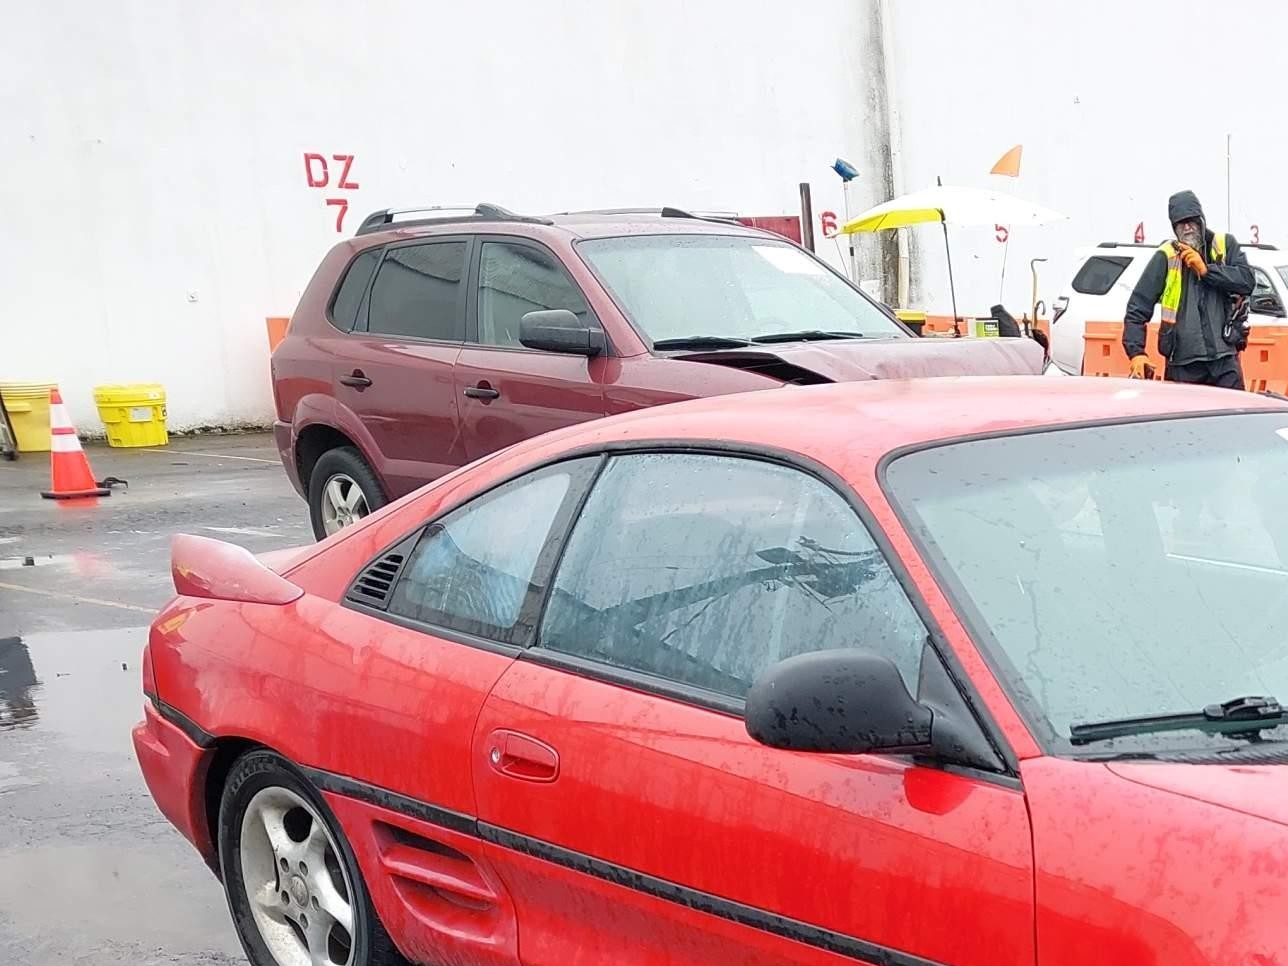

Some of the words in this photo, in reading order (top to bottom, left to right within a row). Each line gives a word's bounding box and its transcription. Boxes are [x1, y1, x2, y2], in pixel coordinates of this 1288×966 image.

[303, 153, 360, 190] DZ
[325, 199, 348, 233] 7
[819, 211, 838, 239] 6
[995, 223, 1010, 243] 5
[1134, 220, 1146, 244] 4
[1250, 224, 1260, 245] 3
